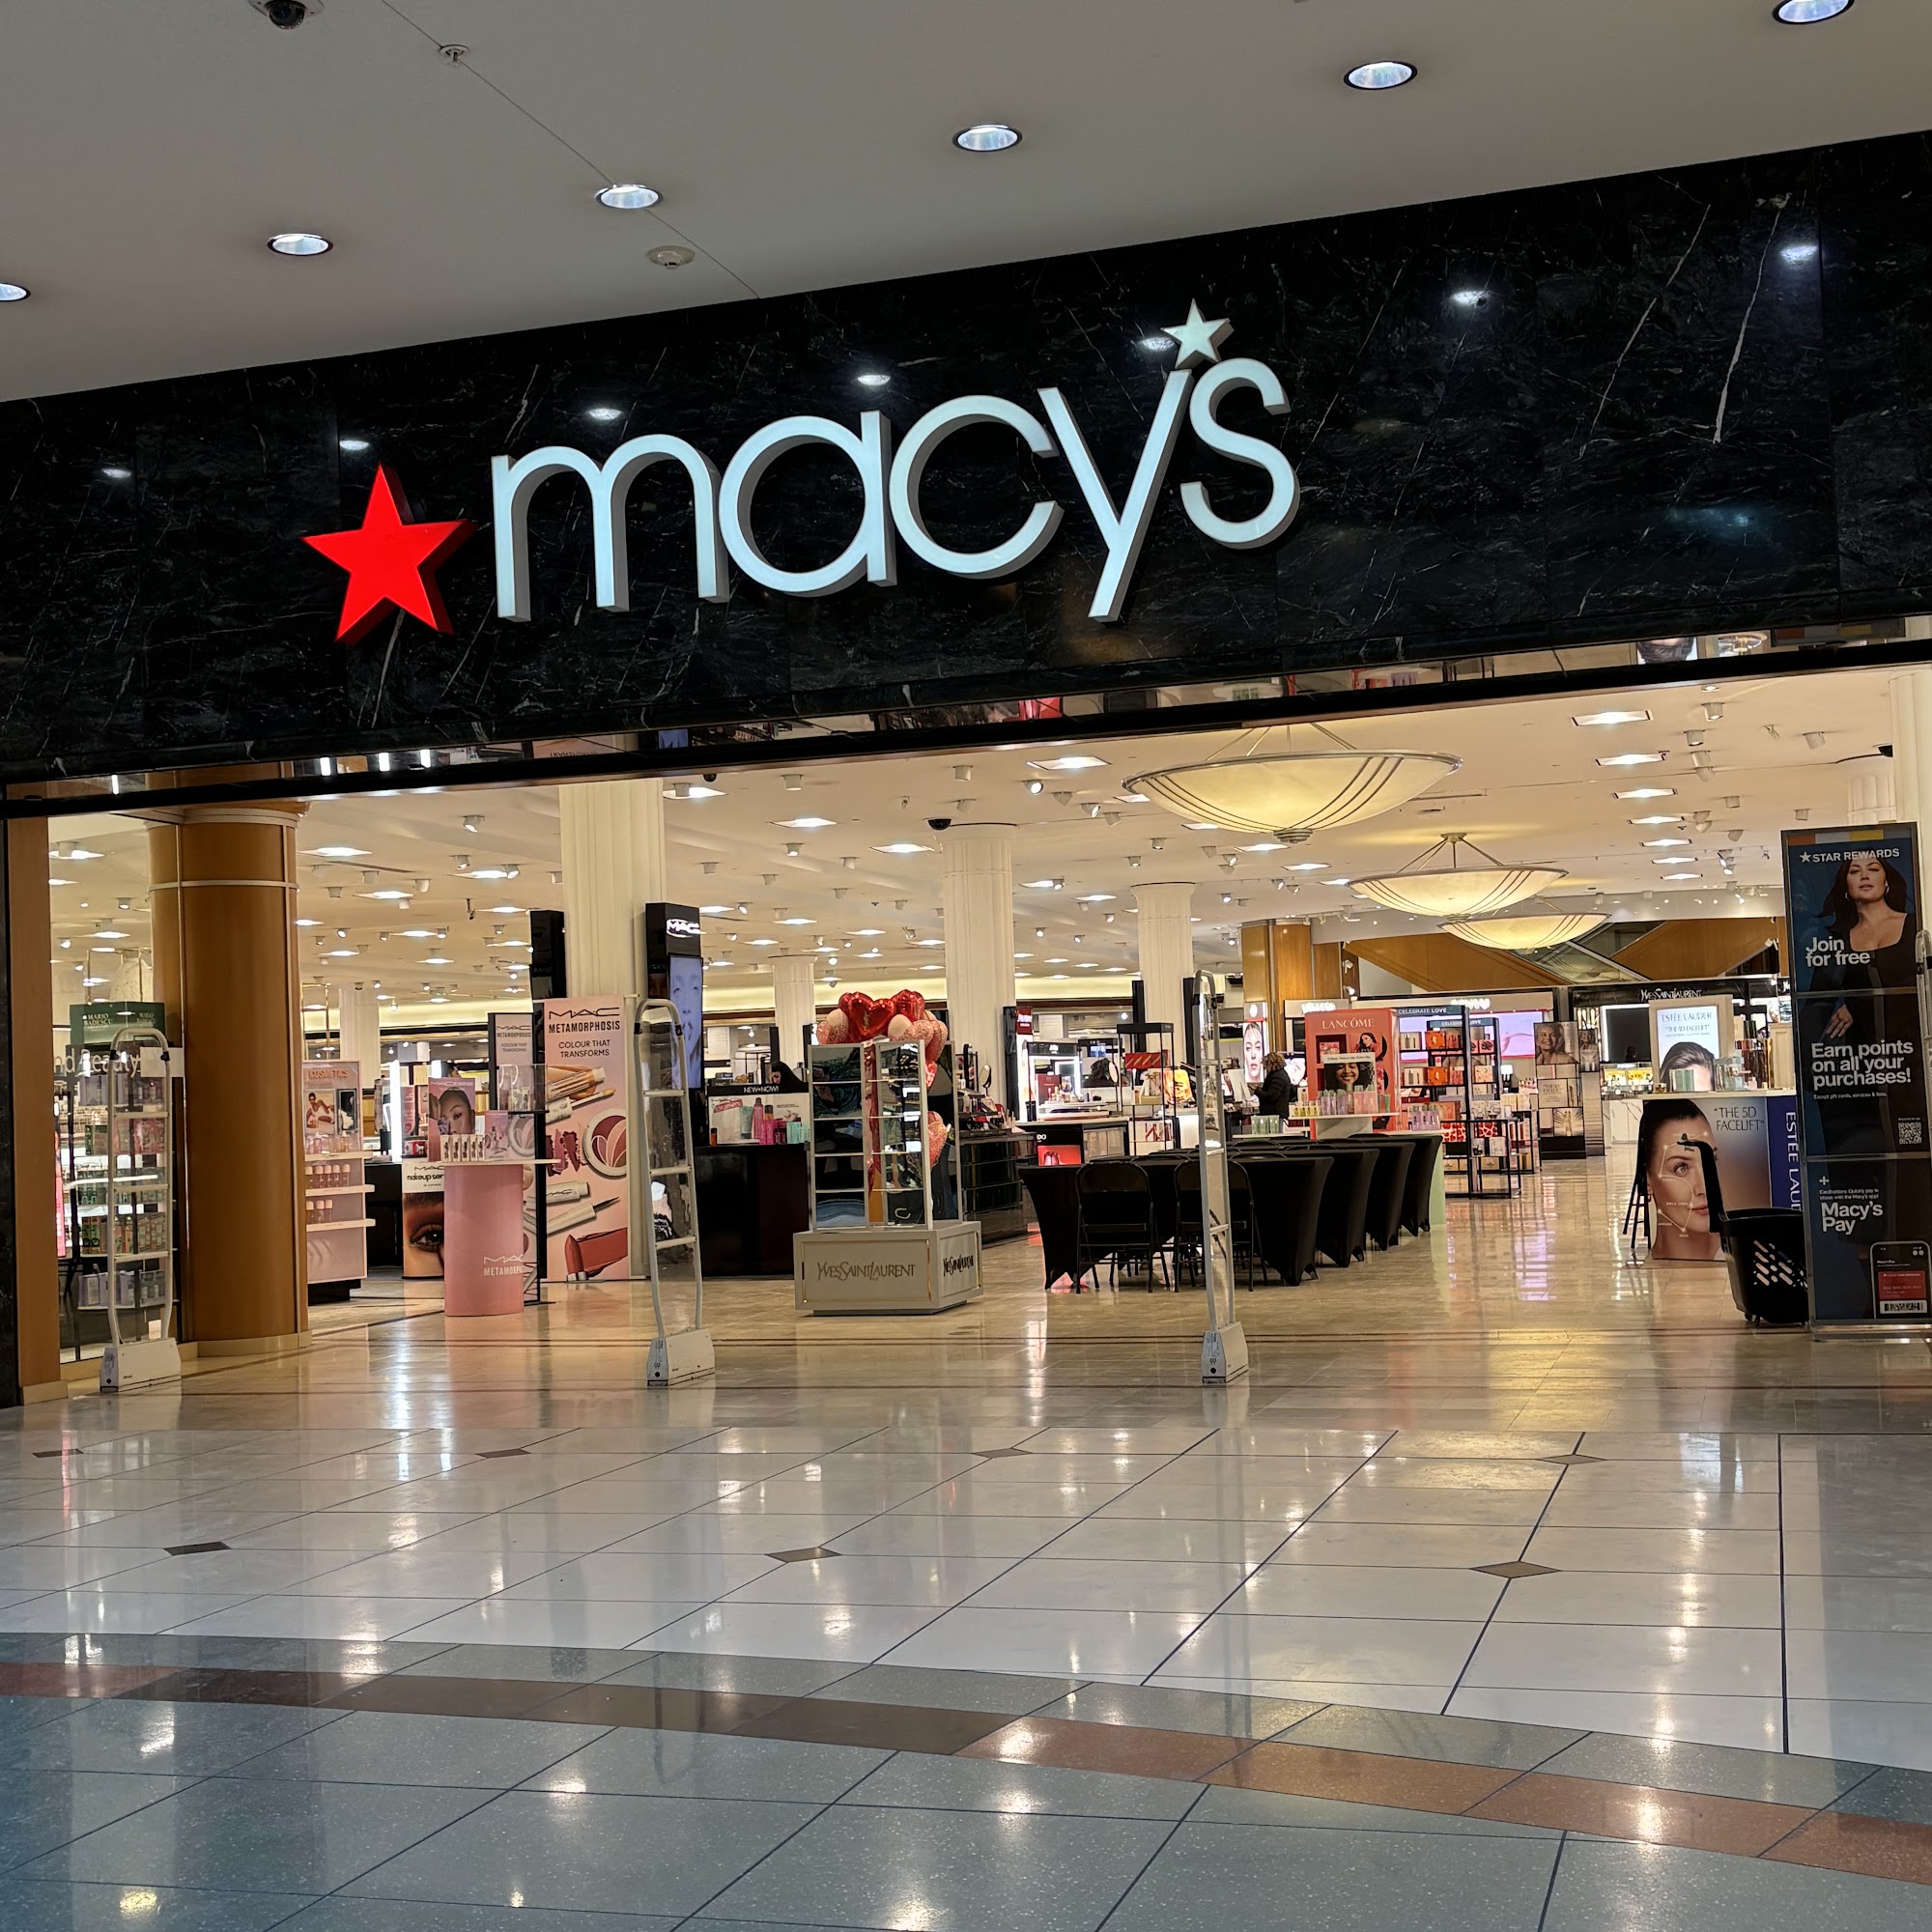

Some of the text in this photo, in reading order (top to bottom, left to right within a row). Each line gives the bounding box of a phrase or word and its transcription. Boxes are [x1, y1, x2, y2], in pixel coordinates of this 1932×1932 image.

[1812, 848, 1900, 863] STAR REWARDS
[1805, 935, 1845, 952] Join
[1805, 951, 1871, 967] for free
[549, 1020, 620, 1034] METAMORPHOSIS
[1321, 1017, 1375, 1030] LANCÔME
[558, 1040, 590, 1049] COLOUR
[1811, 1039, 1914, 1060] Earn points
[53, 1047, 75, 1073] nd
[560, 1049, 611, 1058] TRANSFORMS
[1812, 1056, 1905, 1073] on all your
[1813, 1066, 1912, 1091] purchases!
[1742, 1106, 1757, 1118] 5D
[1821, 1201, 1884, 1221] Macy's
[1822, 1217, 1857, 1236] Pay
